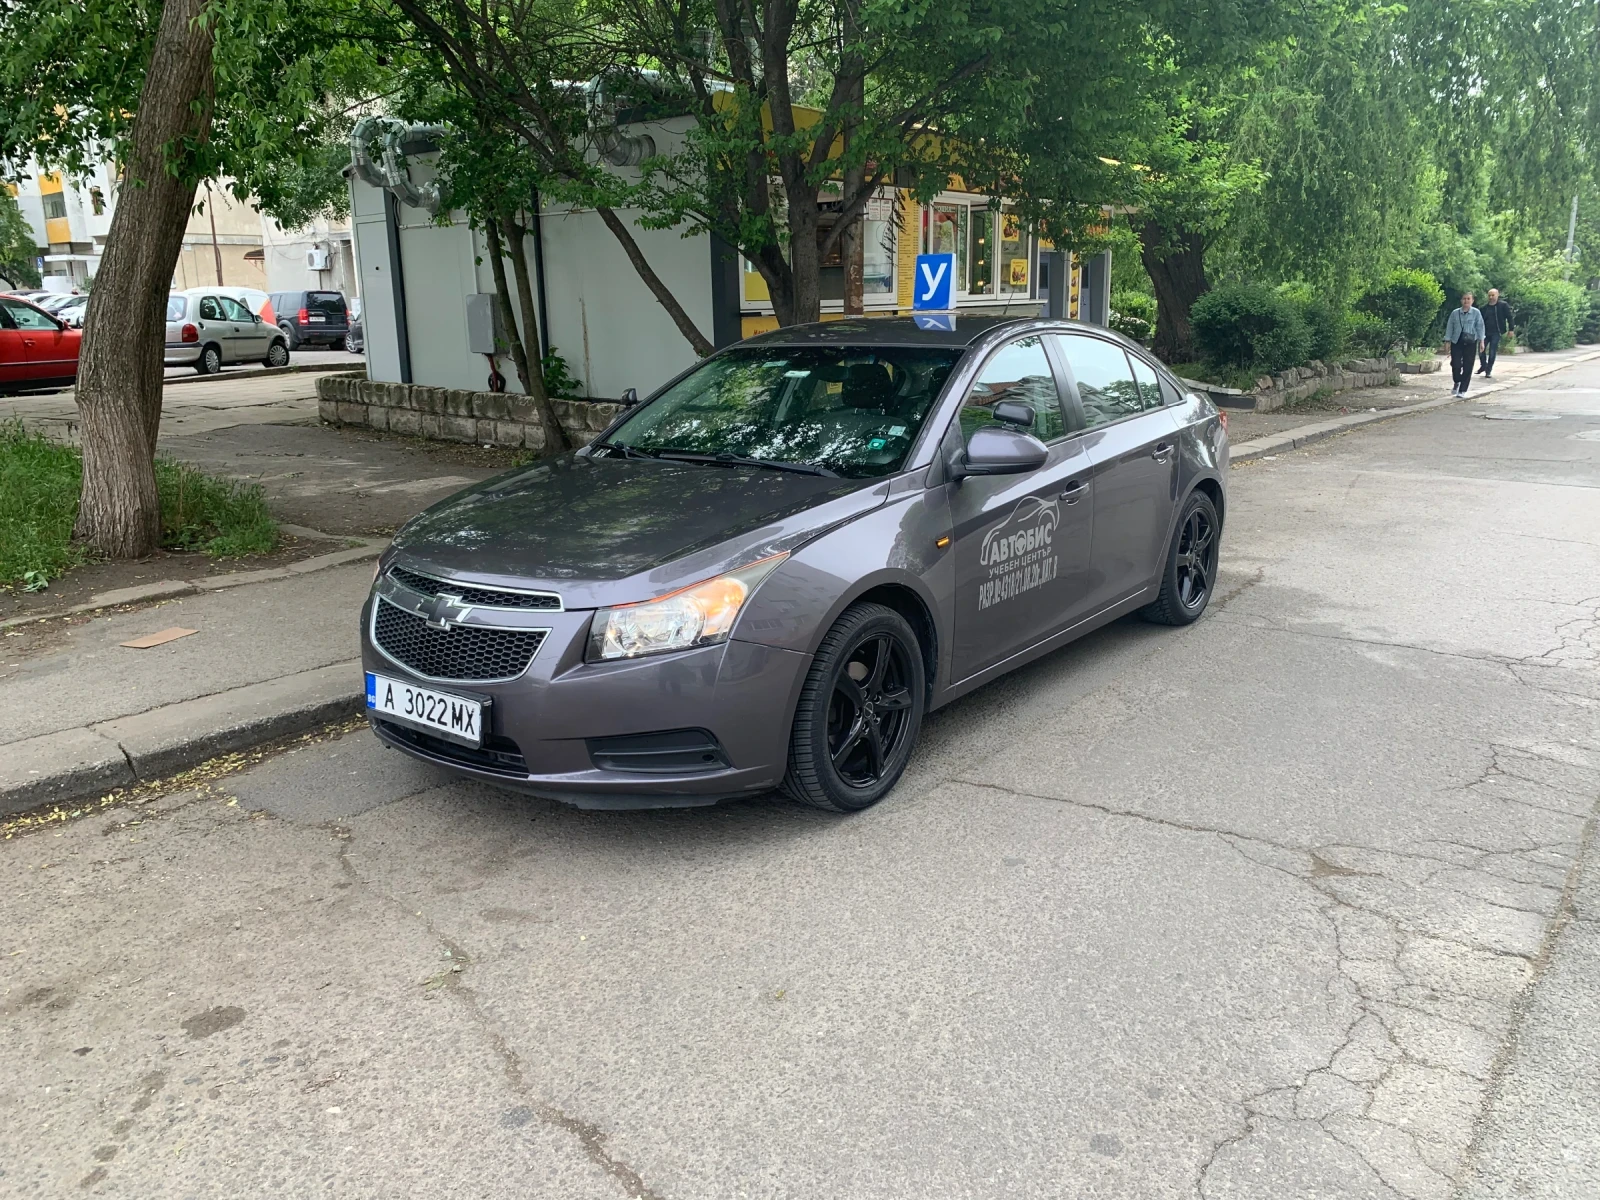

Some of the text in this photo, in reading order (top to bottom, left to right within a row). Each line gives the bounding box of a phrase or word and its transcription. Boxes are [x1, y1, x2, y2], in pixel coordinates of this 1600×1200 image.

[989, 522, 1052, 566] АВТОБИС
[989, 546, 1052, 578] УЧЕБЕН ЦЕНТЪР
[384, 682, 395, 710] A
